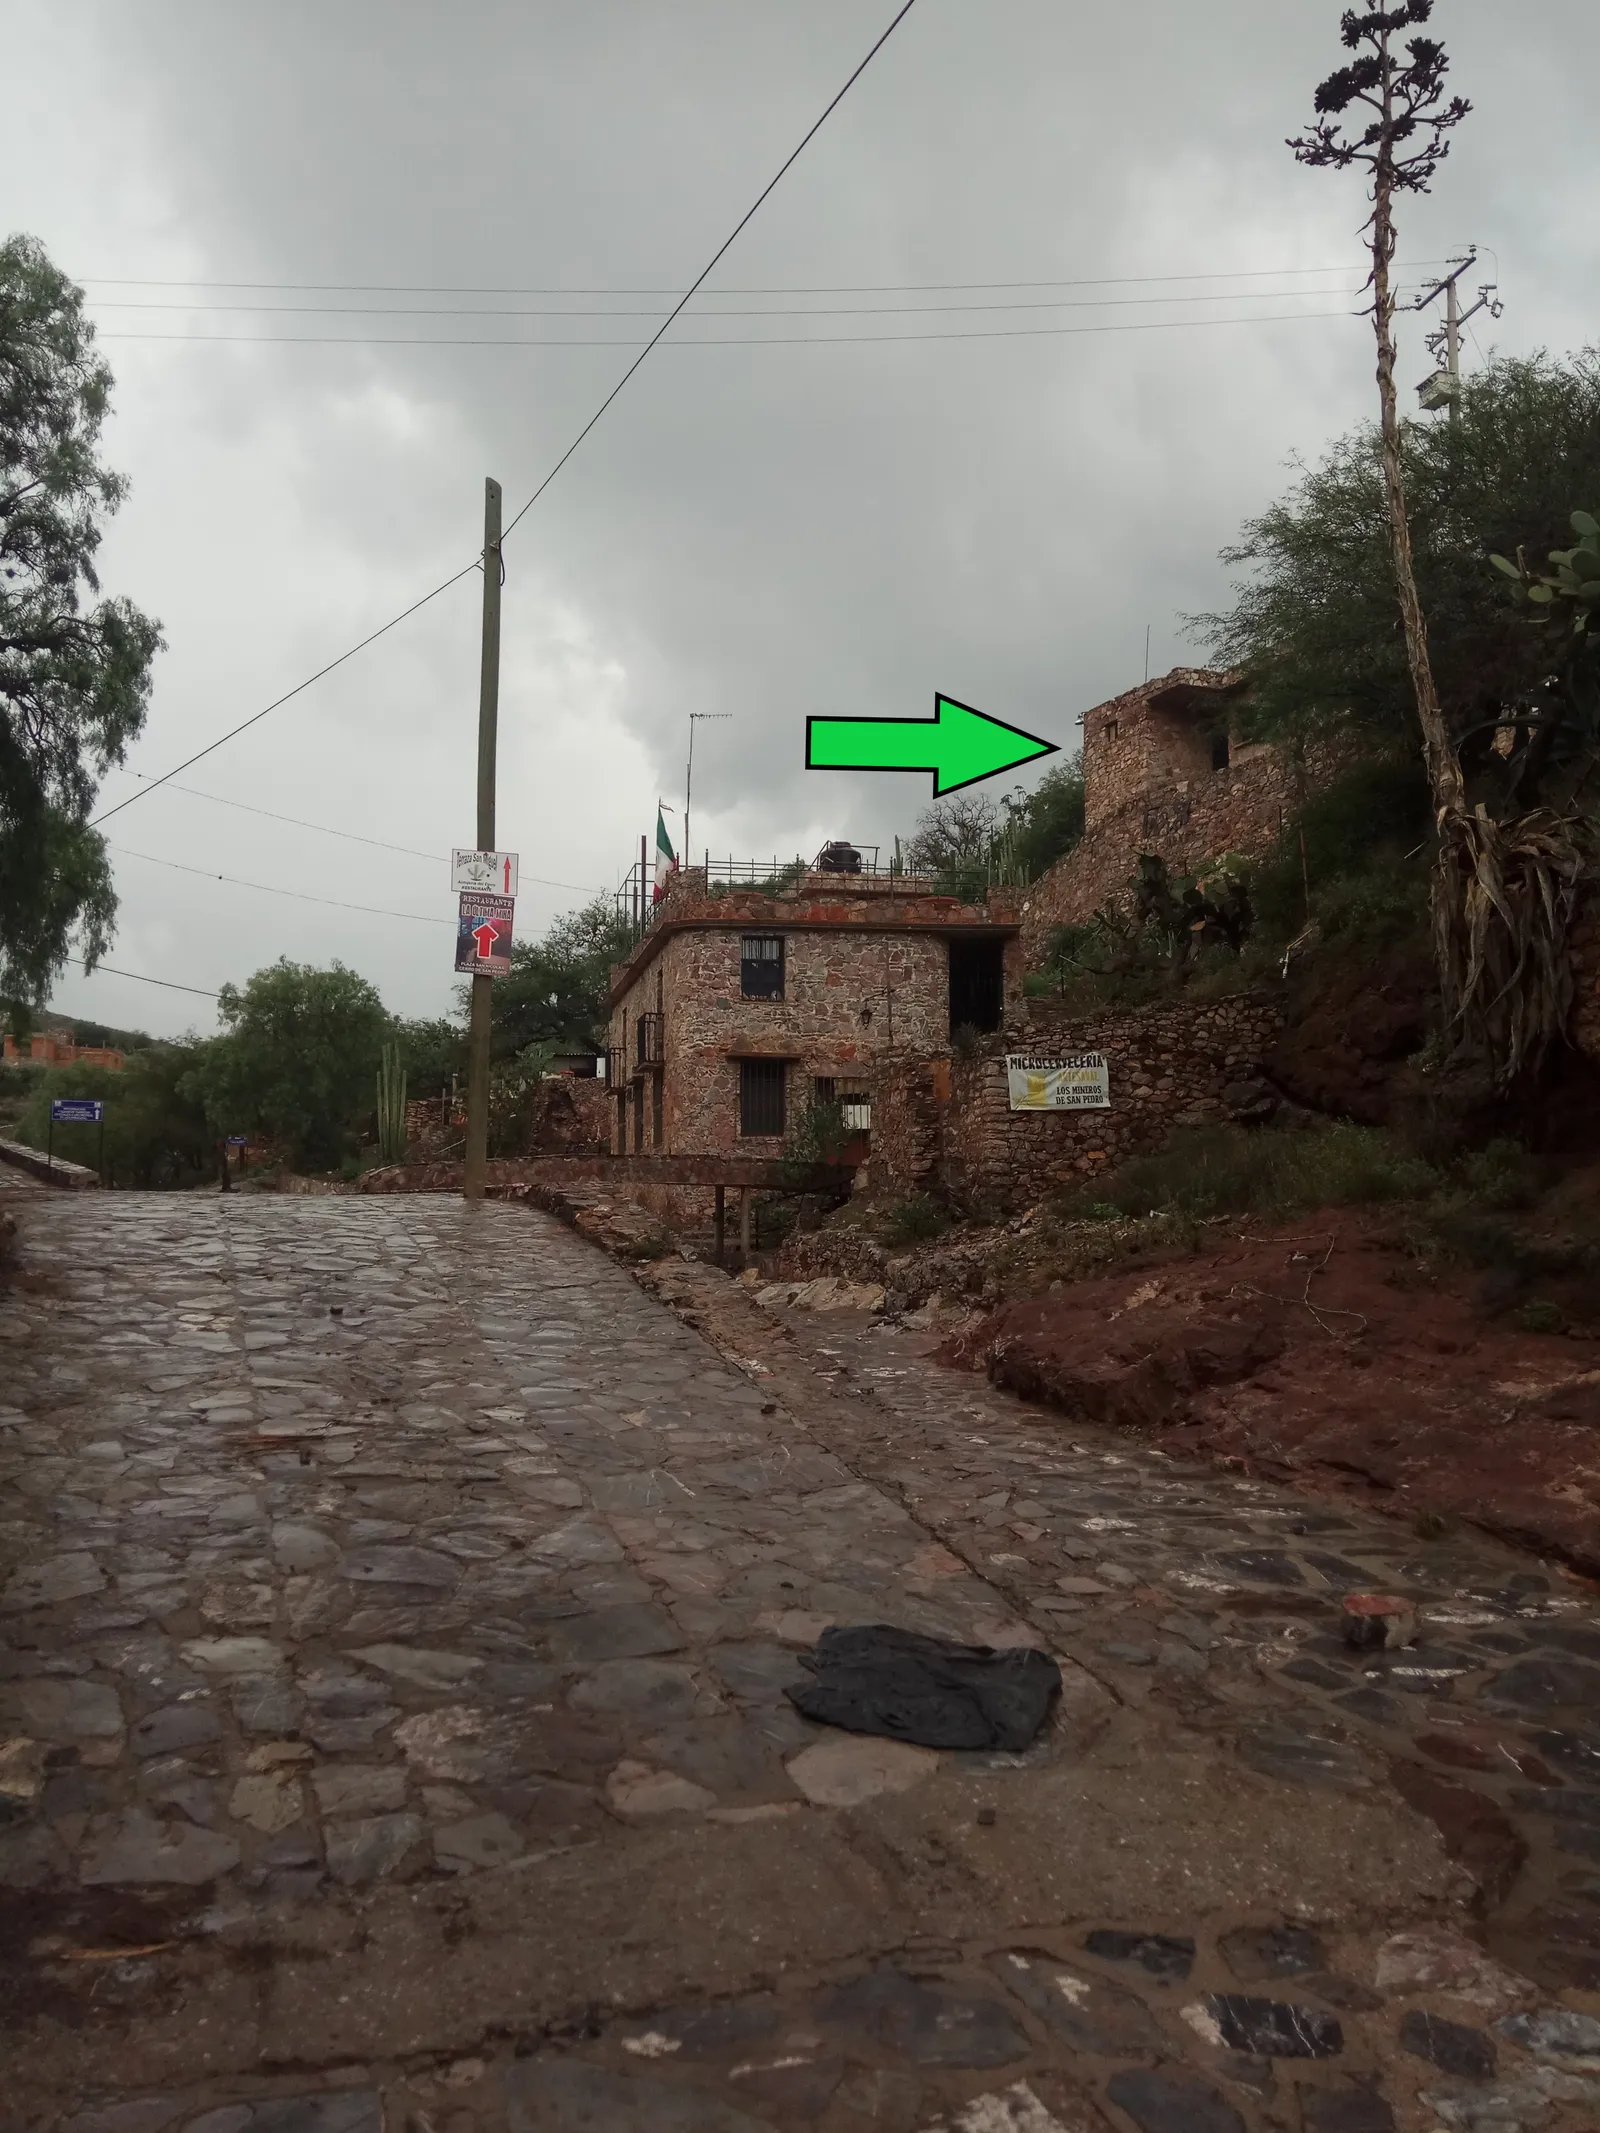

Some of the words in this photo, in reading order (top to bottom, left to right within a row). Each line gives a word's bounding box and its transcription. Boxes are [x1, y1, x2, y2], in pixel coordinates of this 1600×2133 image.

[473, 853, 482, 862] San
[463, 895, 513, 907] RESTAURANTE
[461, 904, 471, 916] LA
[1056, 1086, 1071, 1095] LOS
[1071, 1085, 1102, 1095] MINEROS
[1055, 1097, 1066, 1105] DE
[1066, 1095, 1081, 1104] SAN
[1083, 1095, 1104, 1104] PEDRO
